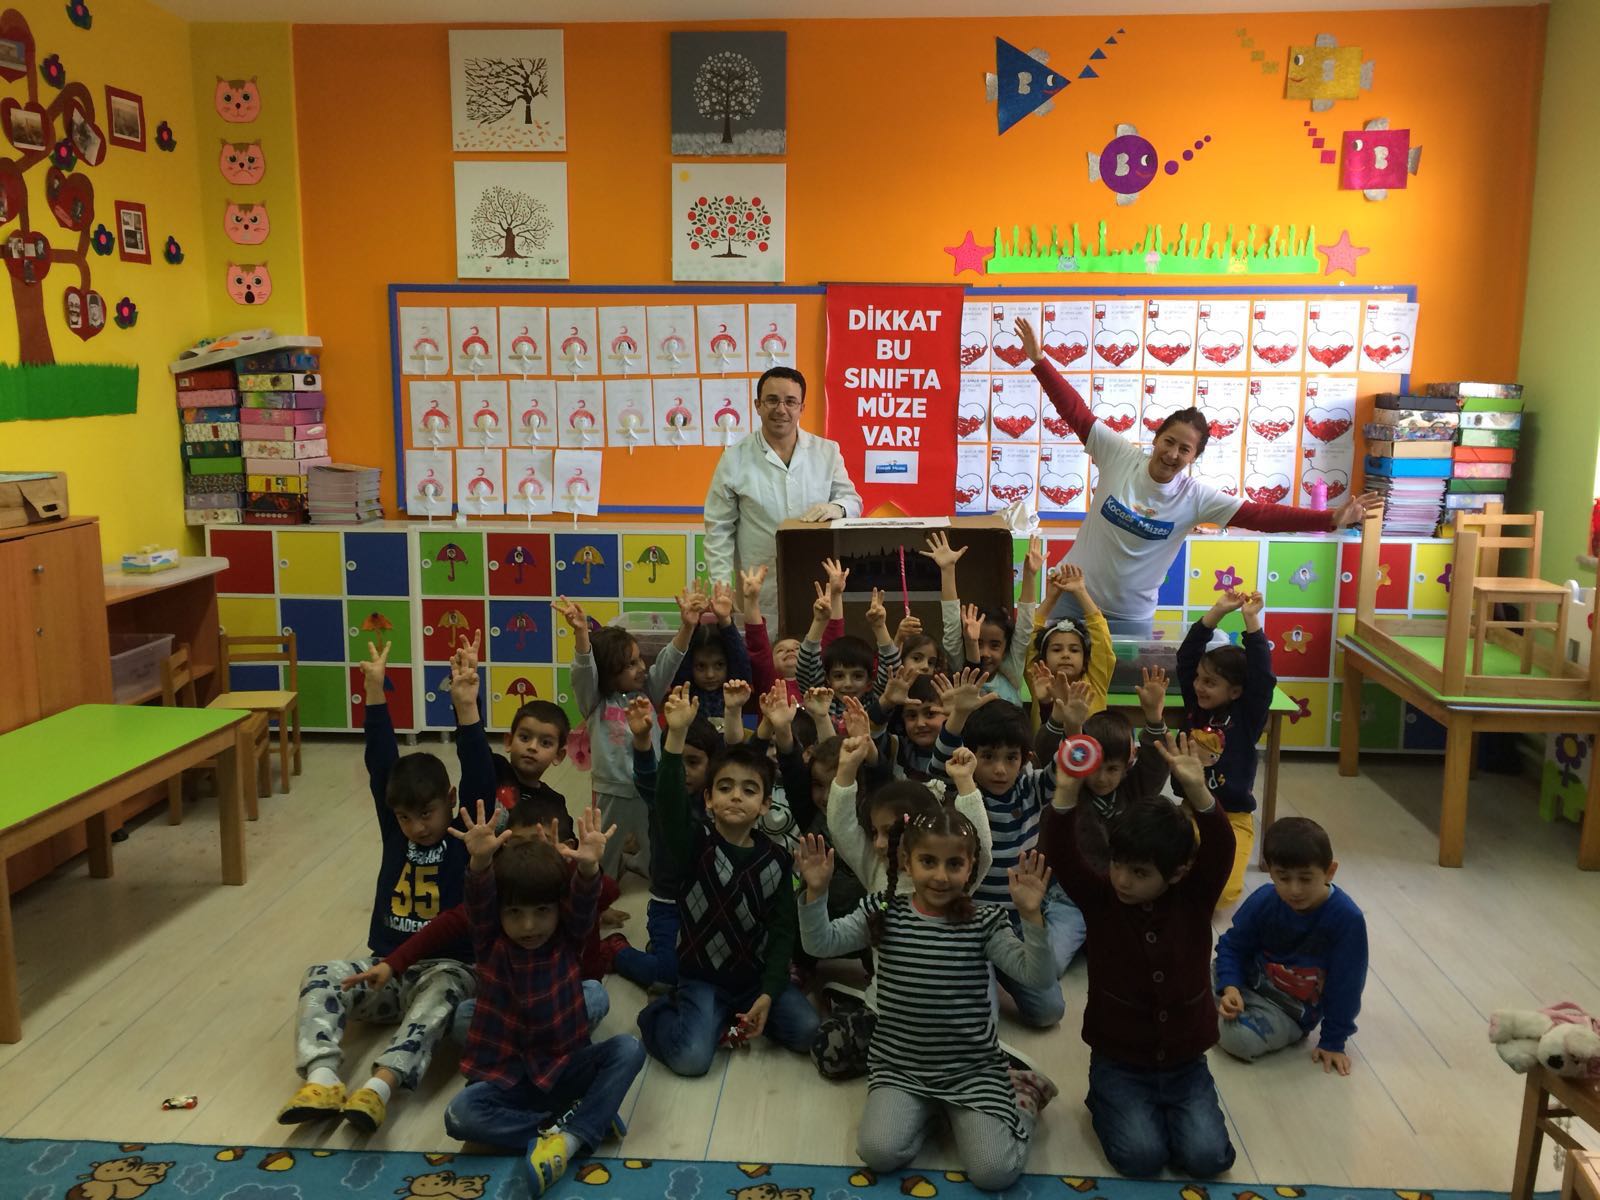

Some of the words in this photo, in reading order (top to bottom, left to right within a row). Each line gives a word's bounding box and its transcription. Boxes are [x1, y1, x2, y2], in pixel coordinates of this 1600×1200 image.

[848, 305, 942, 332] DİKKAT
[876, 339, 911, 361] BU
[844, 368, 942, 390] SINIFTA
[857, 393, 928, 419] MÜZE
[861, 425, 921, 447] VAR!
